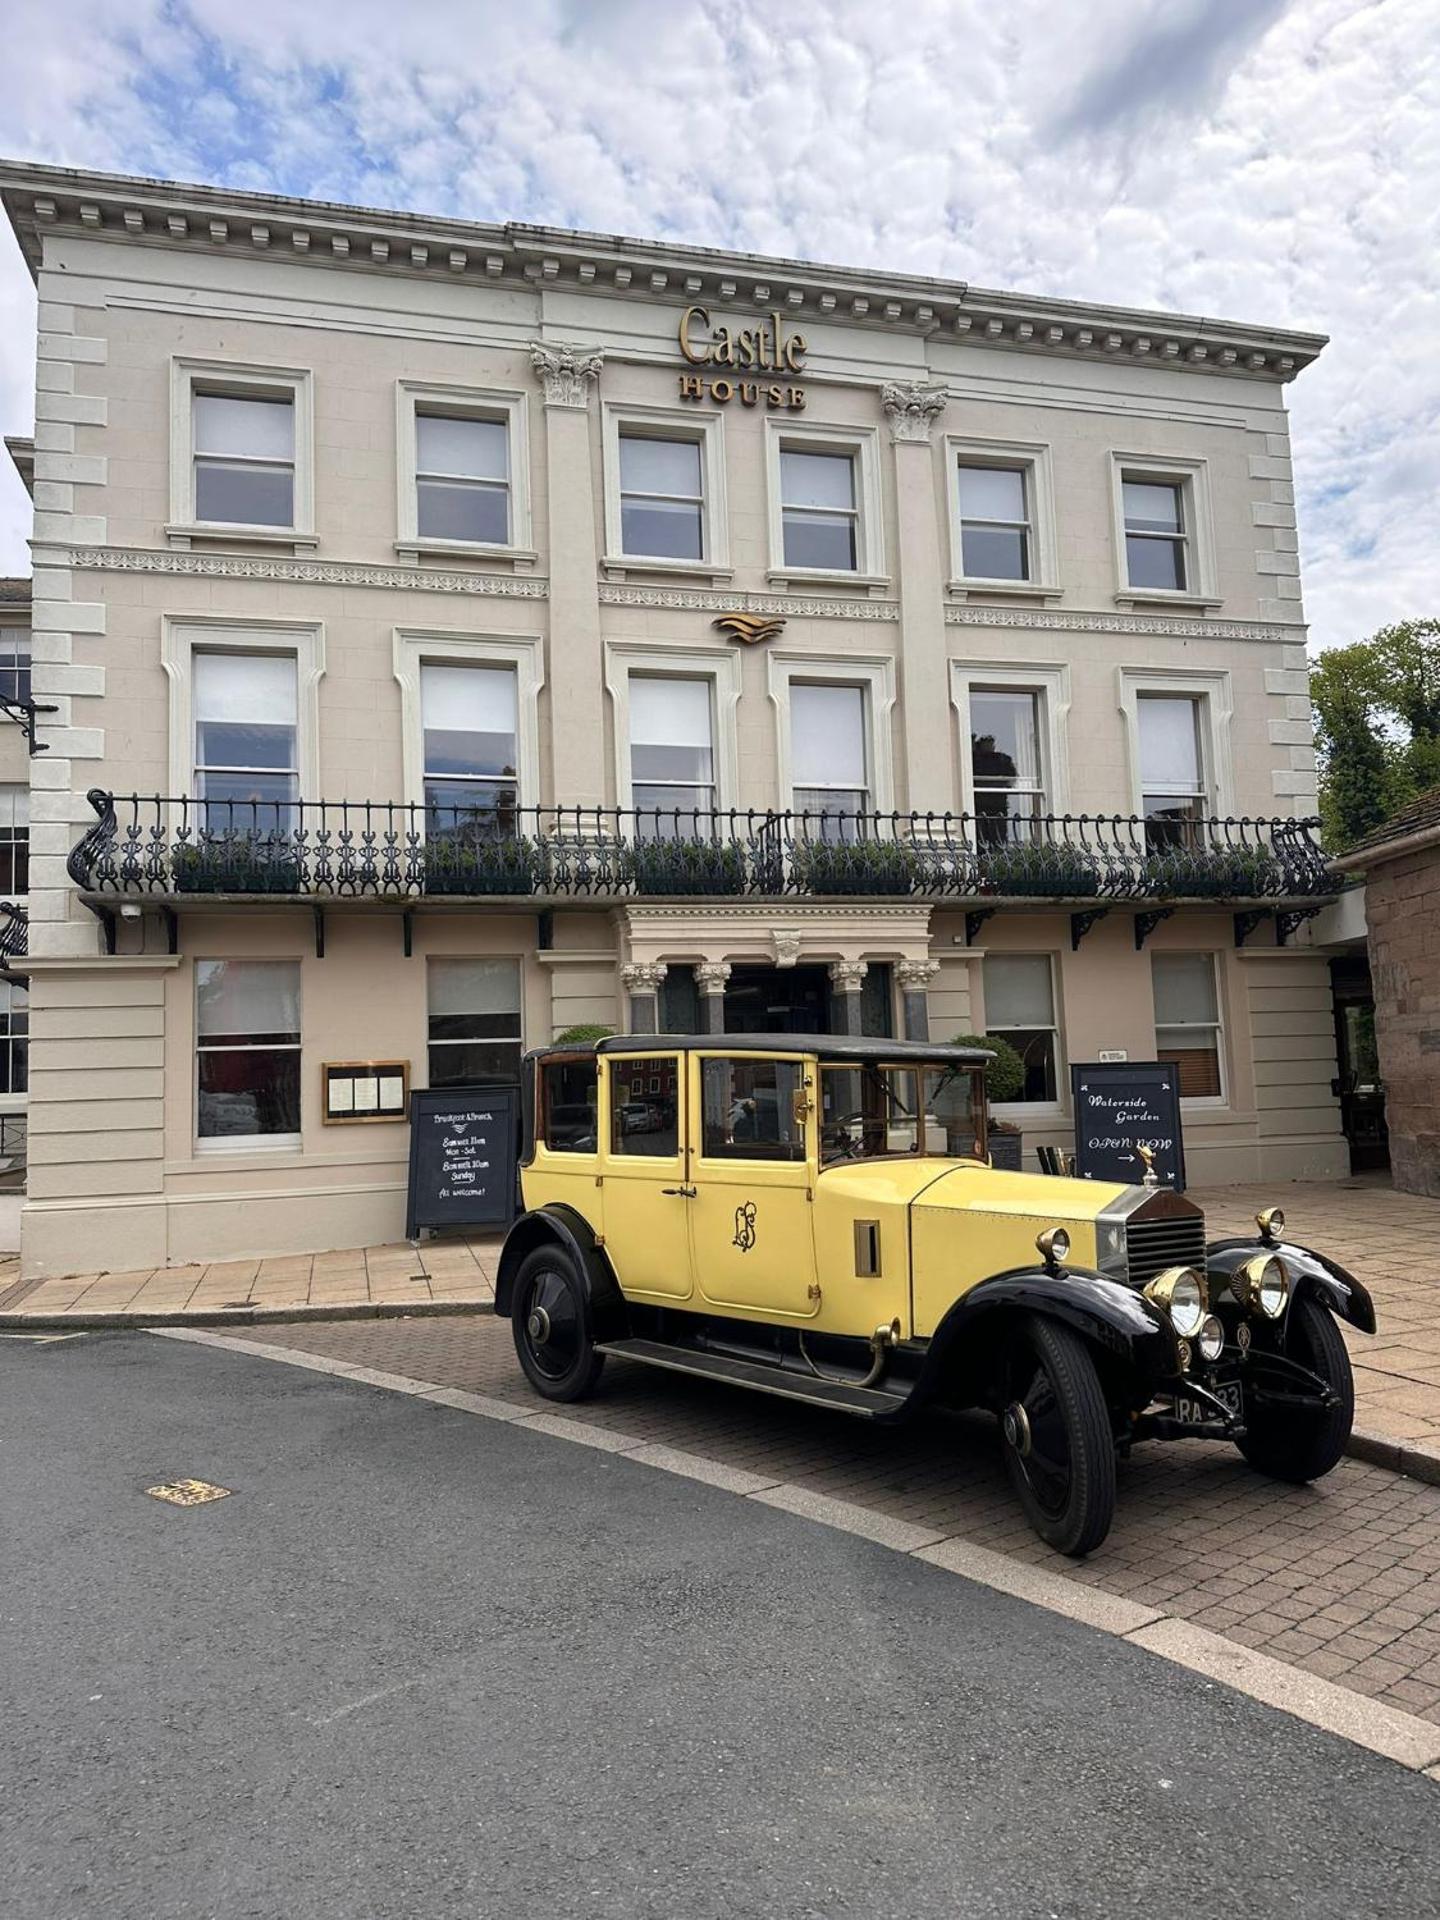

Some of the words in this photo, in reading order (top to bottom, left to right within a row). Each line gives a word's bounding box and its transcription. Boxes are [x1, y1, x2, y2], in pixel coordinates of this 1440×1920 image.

[679, 306, 808, 373] Castle
[679, 376, 808, 410] HOUSE
[1088, 1095, 1147, 1107] Waterside
[1115, 1110, 1160, 1124] Garden
[1088, 1137, 1133, 1149] OPEN
[1136, 1138, 1173, 1149] NOW
[451, 1171, 476, 1182] Sunday
